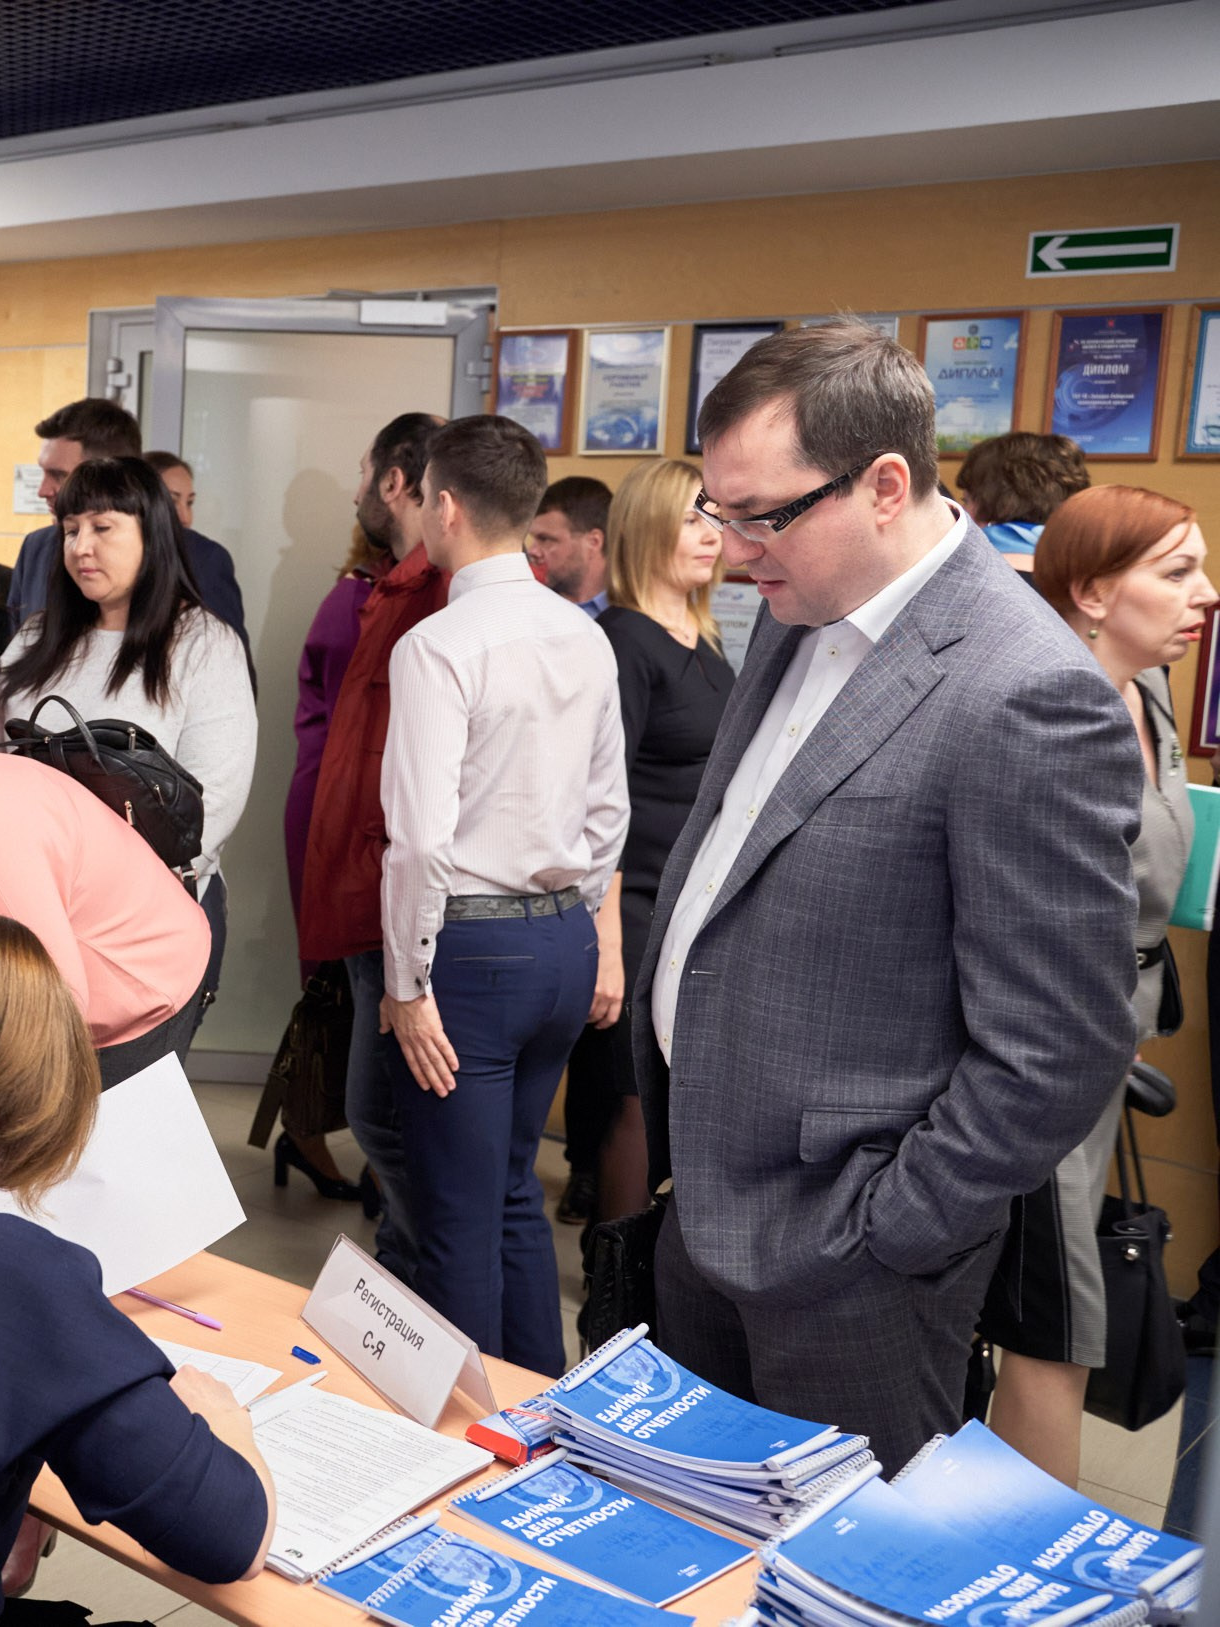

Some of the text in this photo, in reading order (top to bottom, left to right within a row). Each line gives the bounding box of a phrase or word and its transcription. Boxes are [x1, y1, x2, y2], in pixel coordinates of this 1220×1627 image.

[938, 367, 1004, 380] ДИПЛОМ
[1083, 364, 1130, 377] ДИПЛОМ
[353, 1277, 425, 1351] Регистрация
[362, 1331, 386, 1361] С-Я
[595, 1380, 655, 1424] ЕДИНЫЙ
[633, 1384, 712, 1439] ОТЧЕТНОСТИ
[615, 1408, 652, 1434] ДЕНЬ
[500, 1493, 572, 1530] ЕДИНЫЙ
[520, 1516, 564, 1540] ДЕНЬ
[537, 1496, 636, 1547] ОТЧЕТНОСТИ
[1031, 1509, 1110, 1571] ОТЧЕТНОСТИ
[1095, 1518, 1133, 1546] ДЕНЬ
[1102, 1530, 1160, 1571] ЕДИНЫЙ
[492, 1575, 558, 1627] ЕТНОСТИ
[922, 1564, 1019, 1621] ОТЧЕТНОСТИ
[998, 1571, 1043, 1598] ДЕНЬ
[1001, 1582, 1071, 1620] ЕДИНЫЙ
[460, 1610, 495, 1627] ЕНЬ
